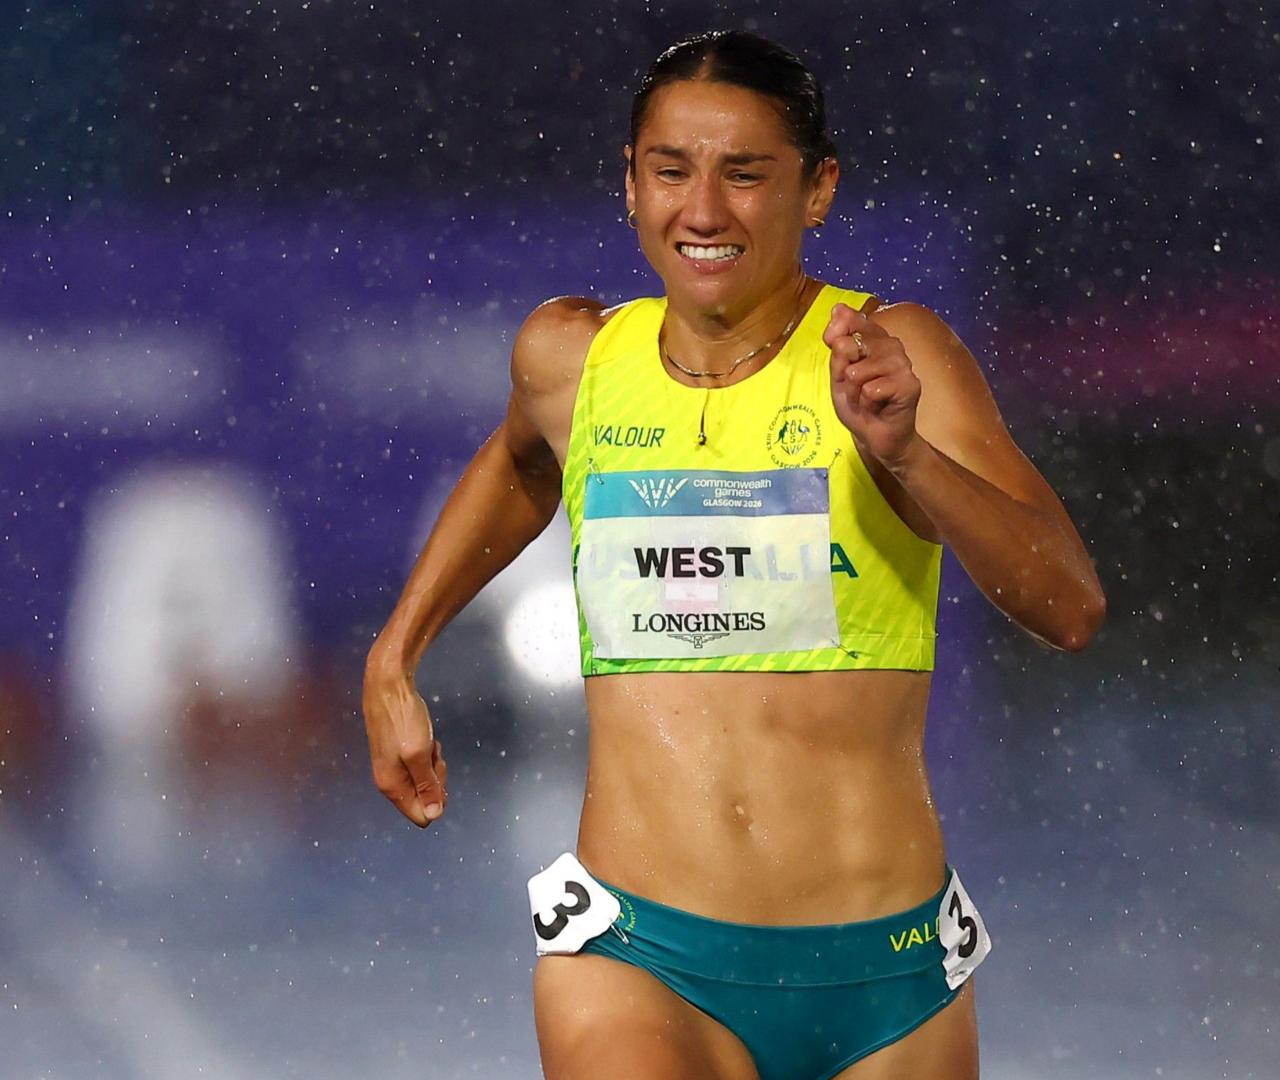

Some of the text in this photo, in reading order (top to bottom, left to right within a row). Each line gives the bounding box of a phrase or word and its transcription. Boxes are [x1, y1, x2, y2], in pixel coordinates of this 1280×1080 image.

[594, 425, 665, 448] VALOUR
[693, 479, 772, 489] commonwealth
[714, 487, 752, 498] games
[703, 499, 762, 508] GLASGOW 2026
[634, 547, 751, 578] WEST
[632, 612, 766, 632] LONGINES
[533, 881, 591, 940] 3
[948, 891, 978, 958] 3
